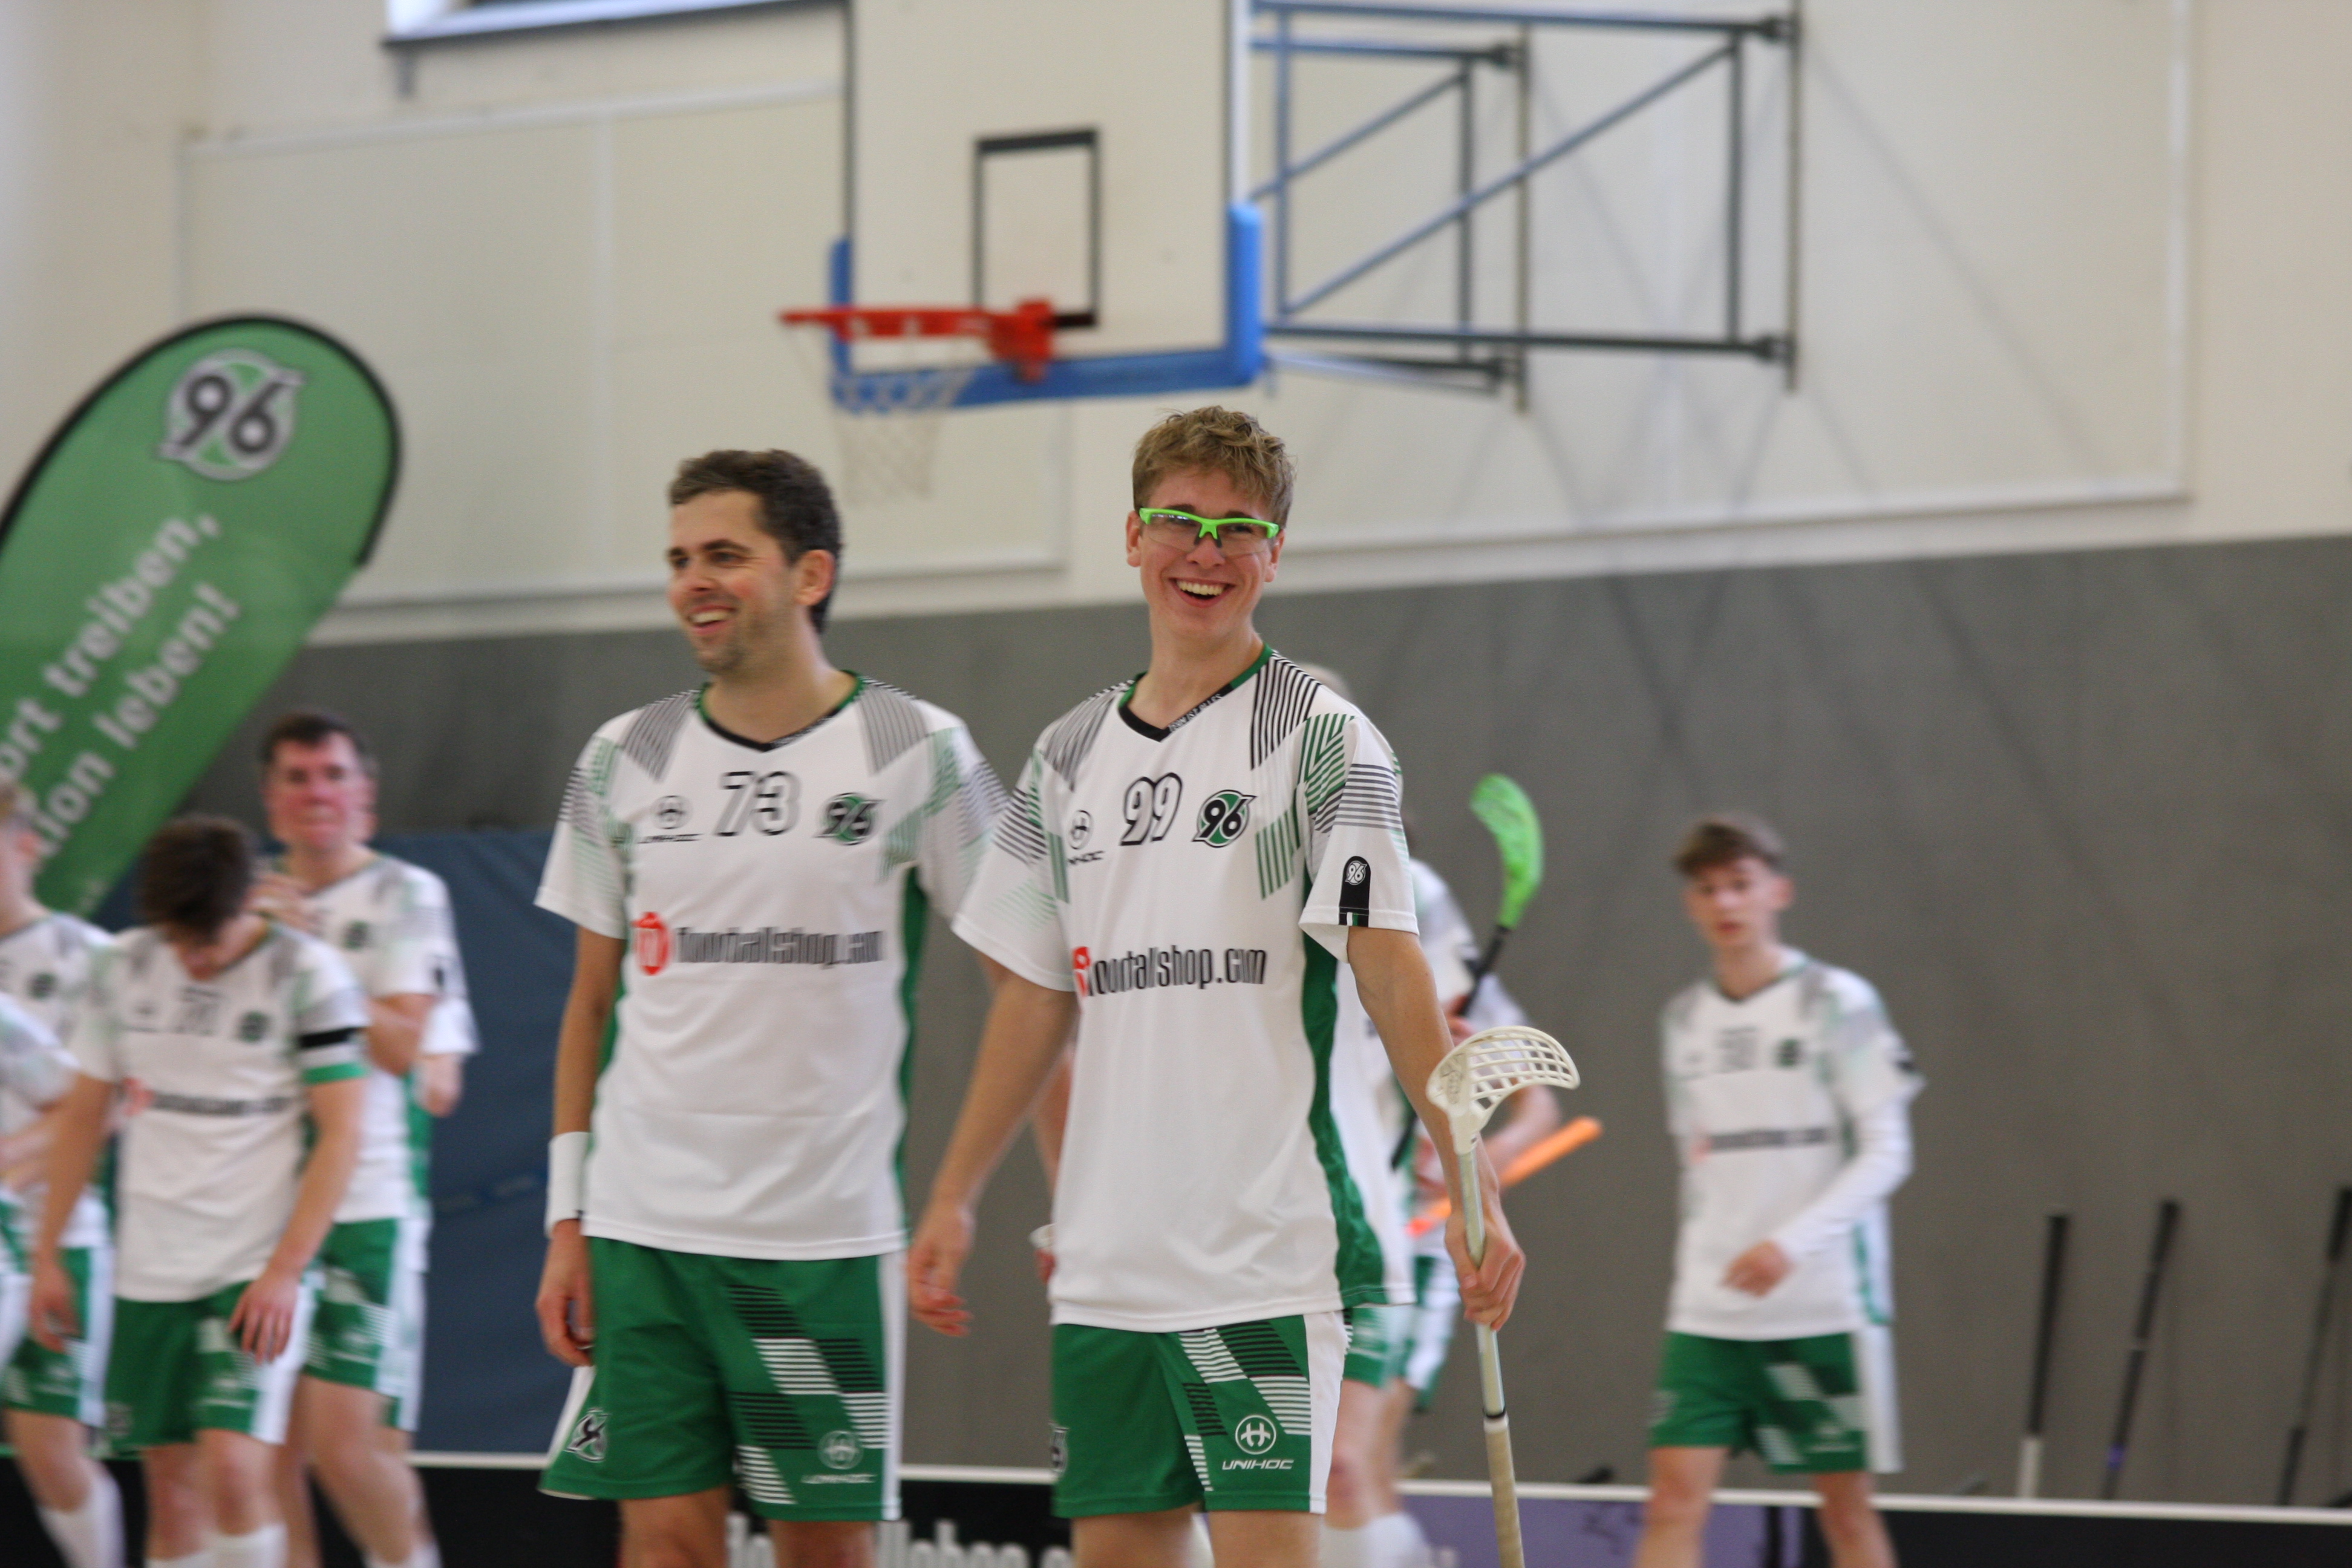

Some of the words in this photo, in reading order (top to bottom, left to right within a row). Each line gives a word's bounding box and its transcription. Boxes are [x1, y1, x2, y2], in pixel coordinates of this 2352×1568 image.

[180, 374, 286, 456] 96
[714, 771, 801, 837] 73
[1119, 772, 1183, 846] 99
[1222, 1459, 1294, 1470] UNIHOC
